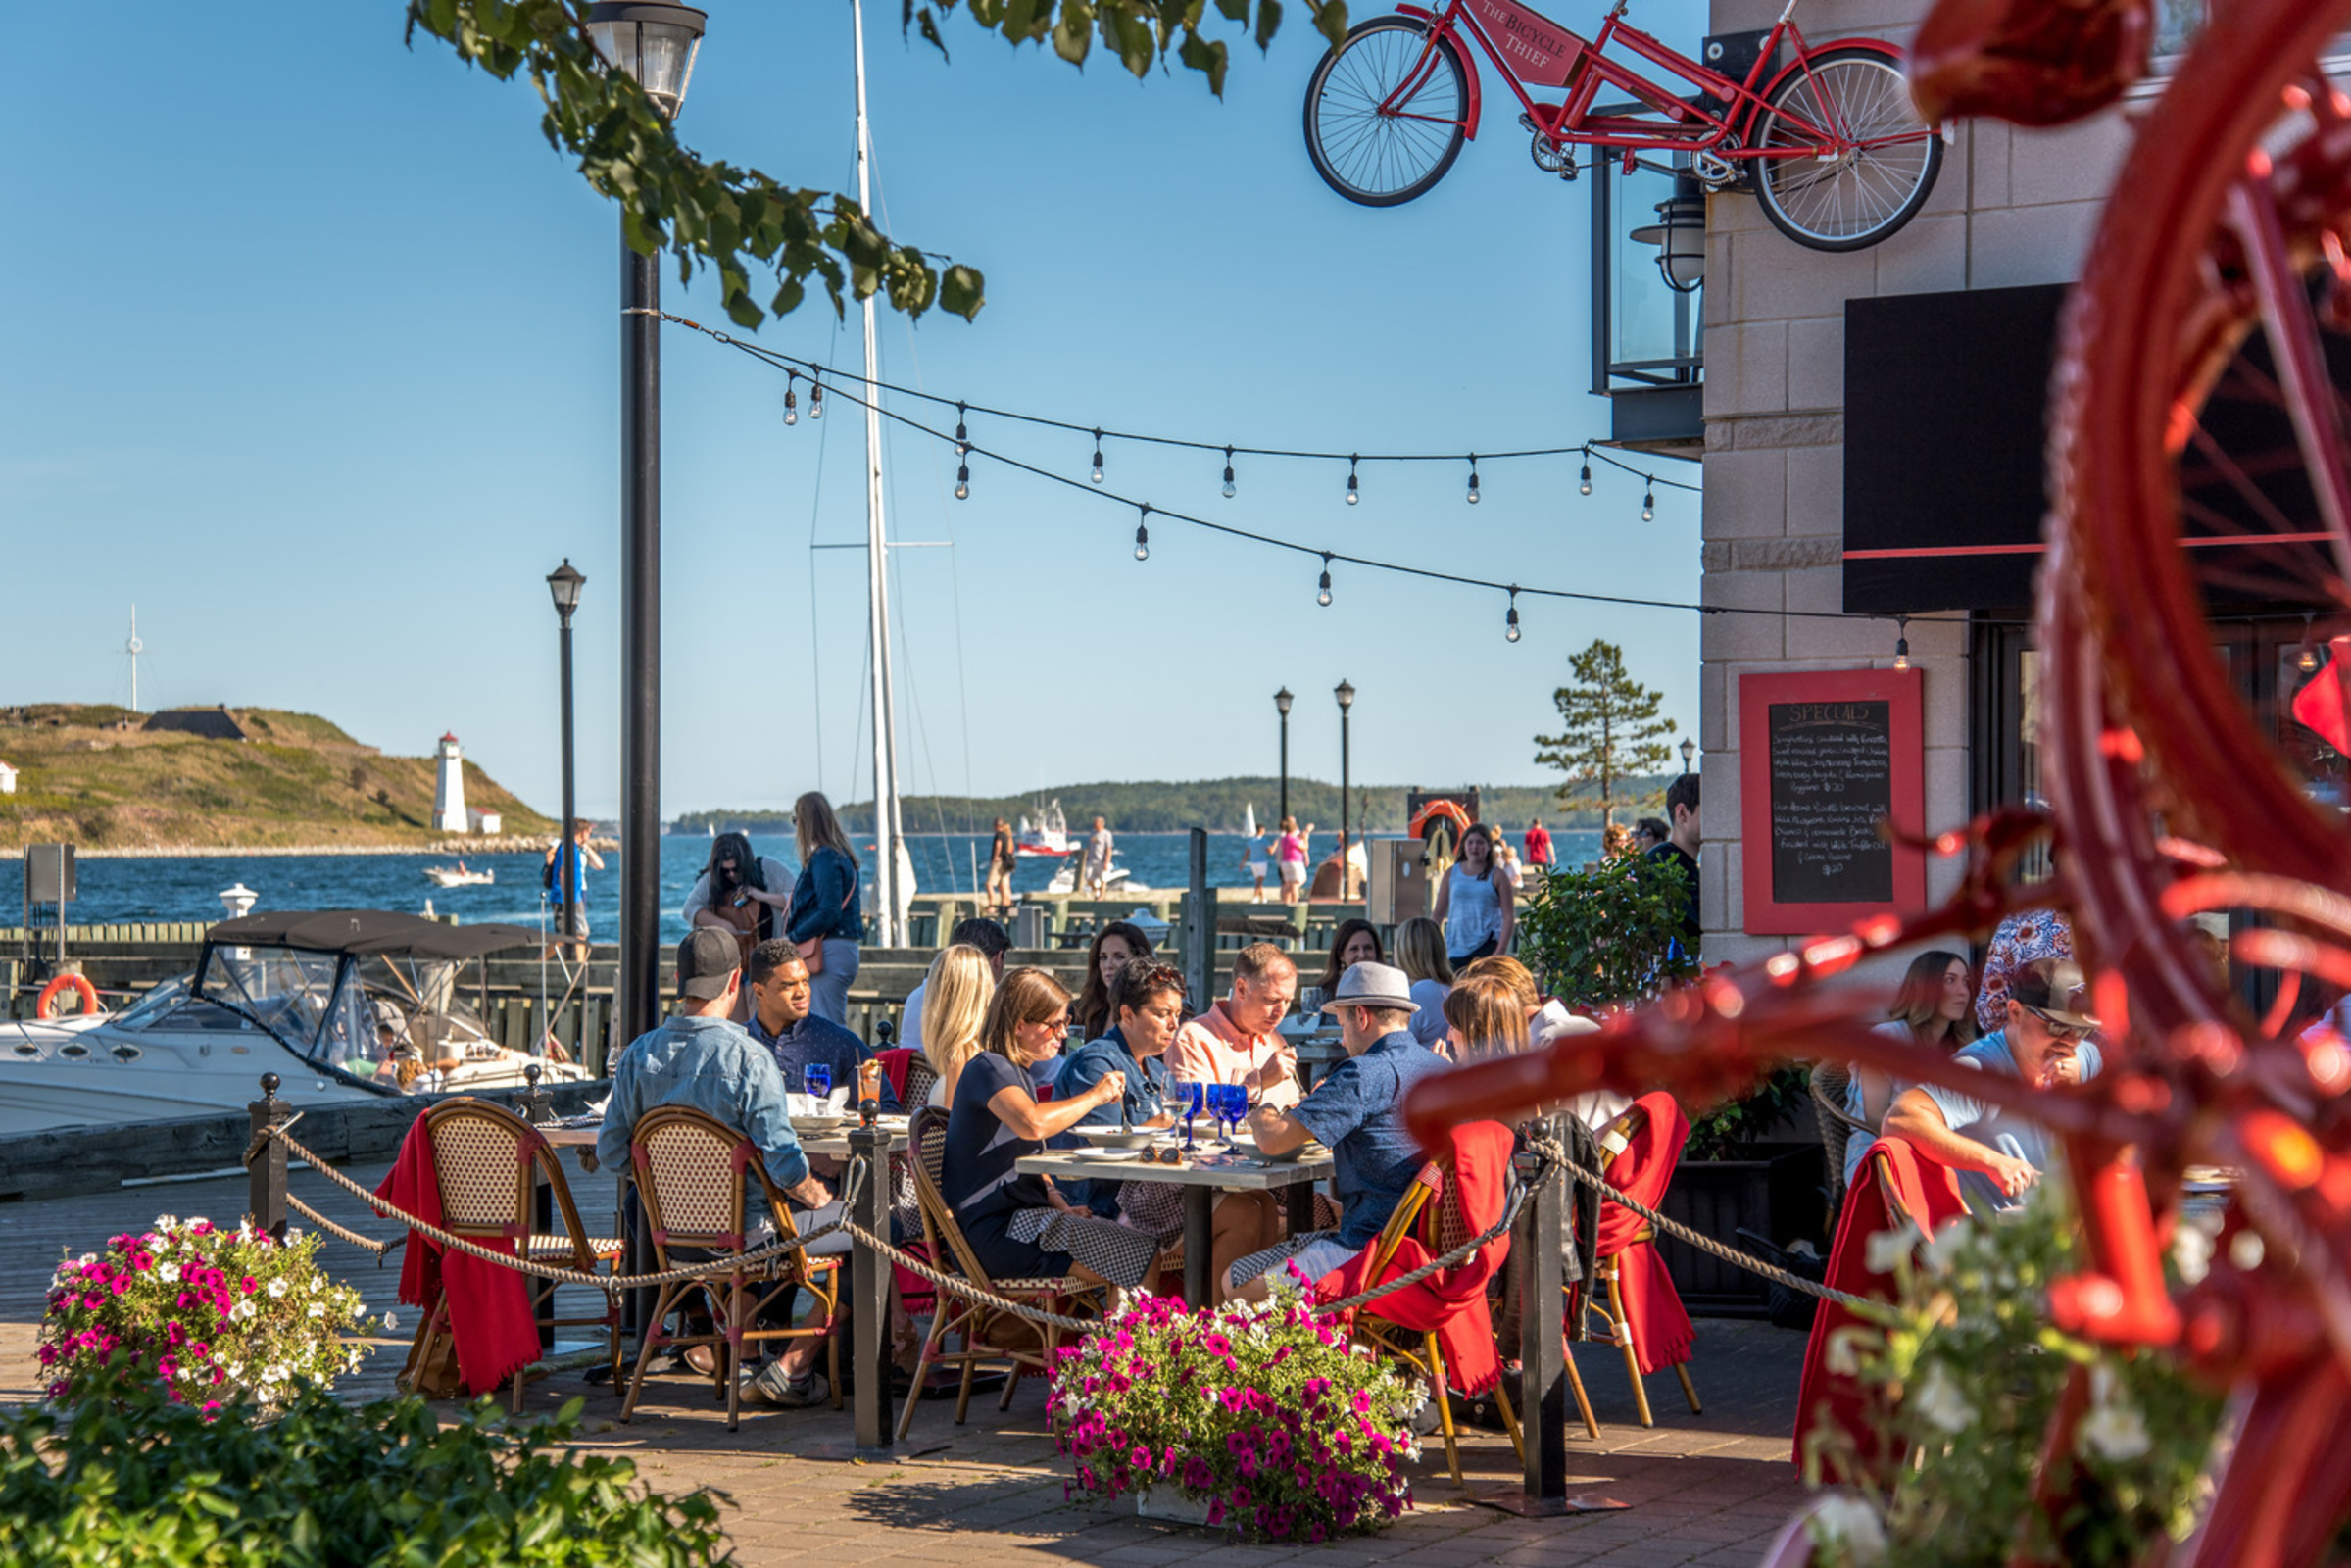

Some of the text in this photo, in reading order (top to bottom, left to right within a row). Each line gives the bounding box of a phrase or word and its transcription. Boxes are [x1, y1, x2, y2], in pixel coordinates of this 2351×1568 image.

[1482, 0, 1567, 58] THE BICYCLE
[1505, 33, 1550, 69] THIEF
[1789, 704, 1870, 723] SPECIALS
